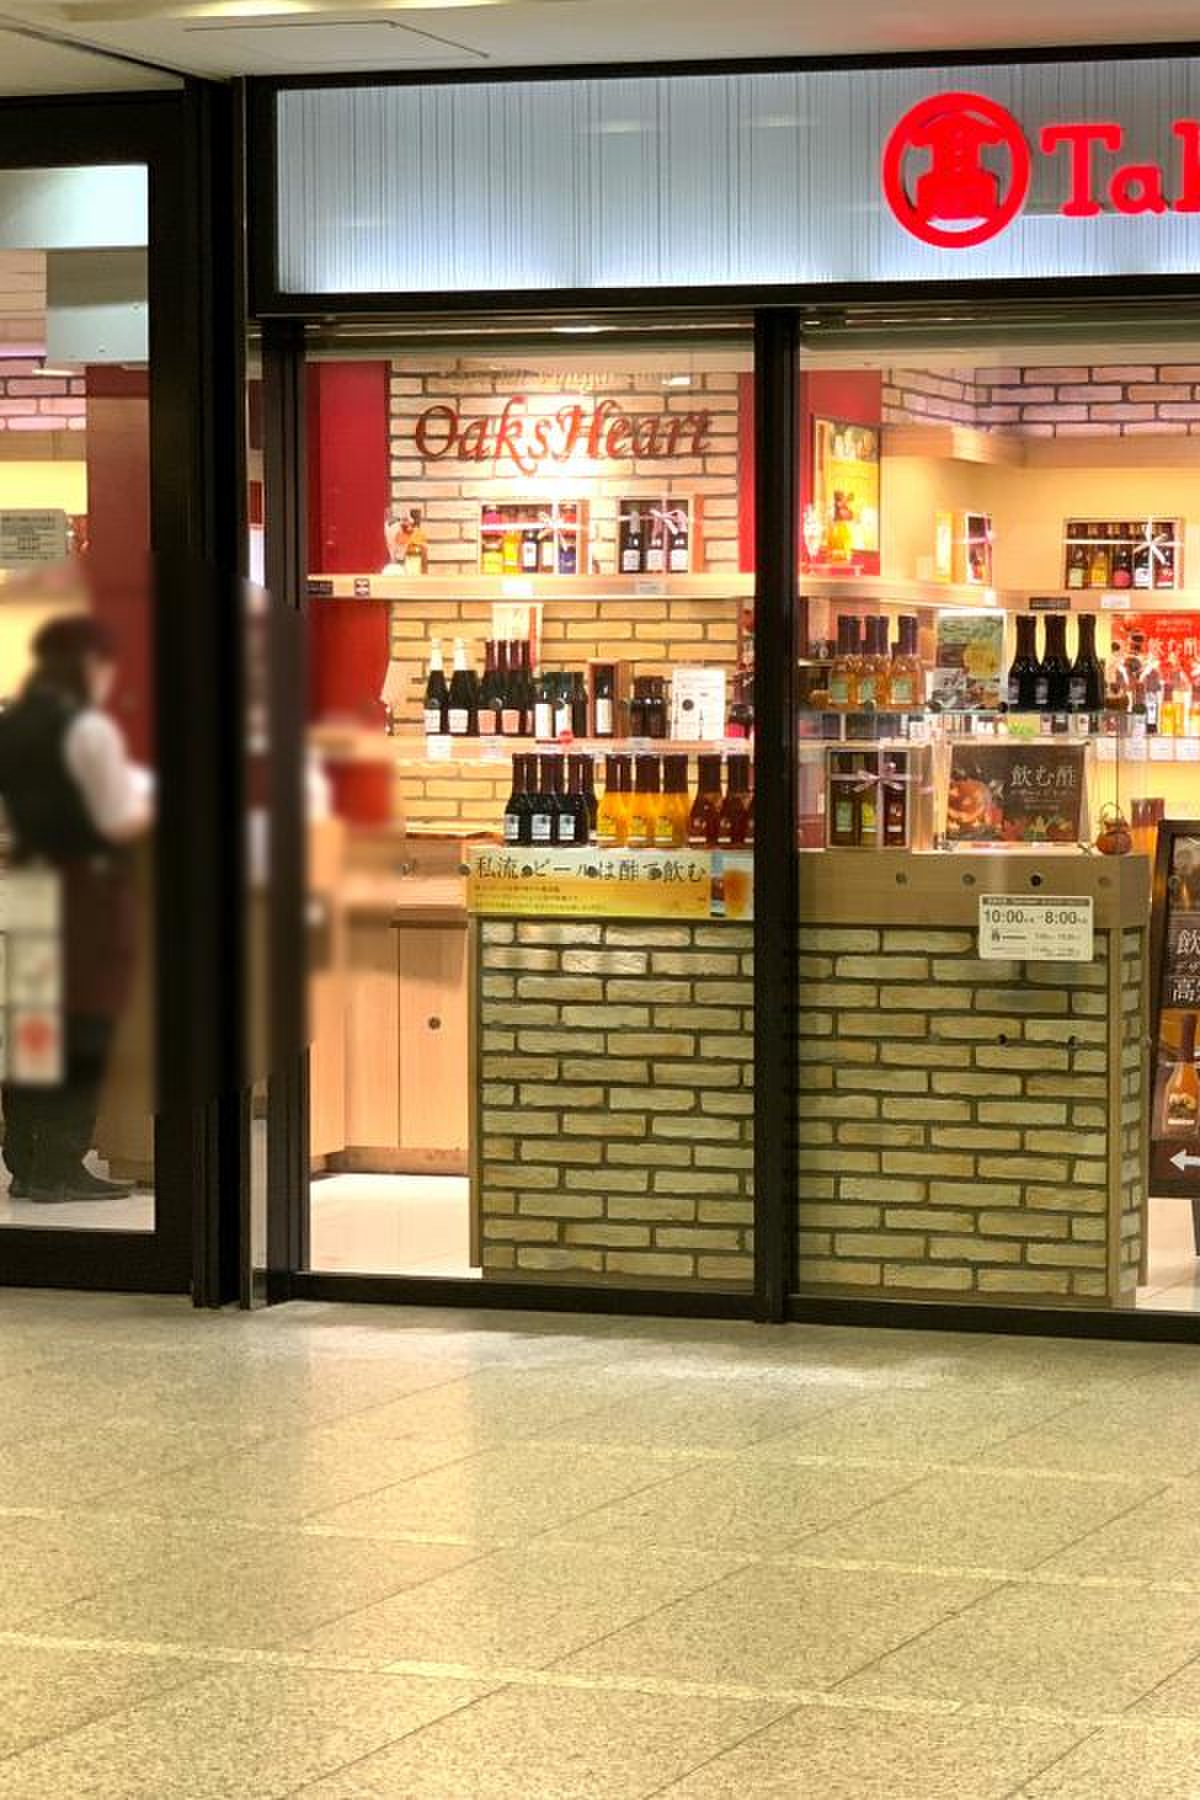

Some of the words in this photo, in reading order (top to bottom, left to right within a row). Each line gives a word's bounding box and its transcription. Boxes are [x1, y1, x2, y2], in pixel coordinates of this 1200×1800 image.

[1010, 764, 1076, 787] 飲む酢
[984, 909, 1024, 923] 10:00
[1044, 911, 1077, 924] 8:00
